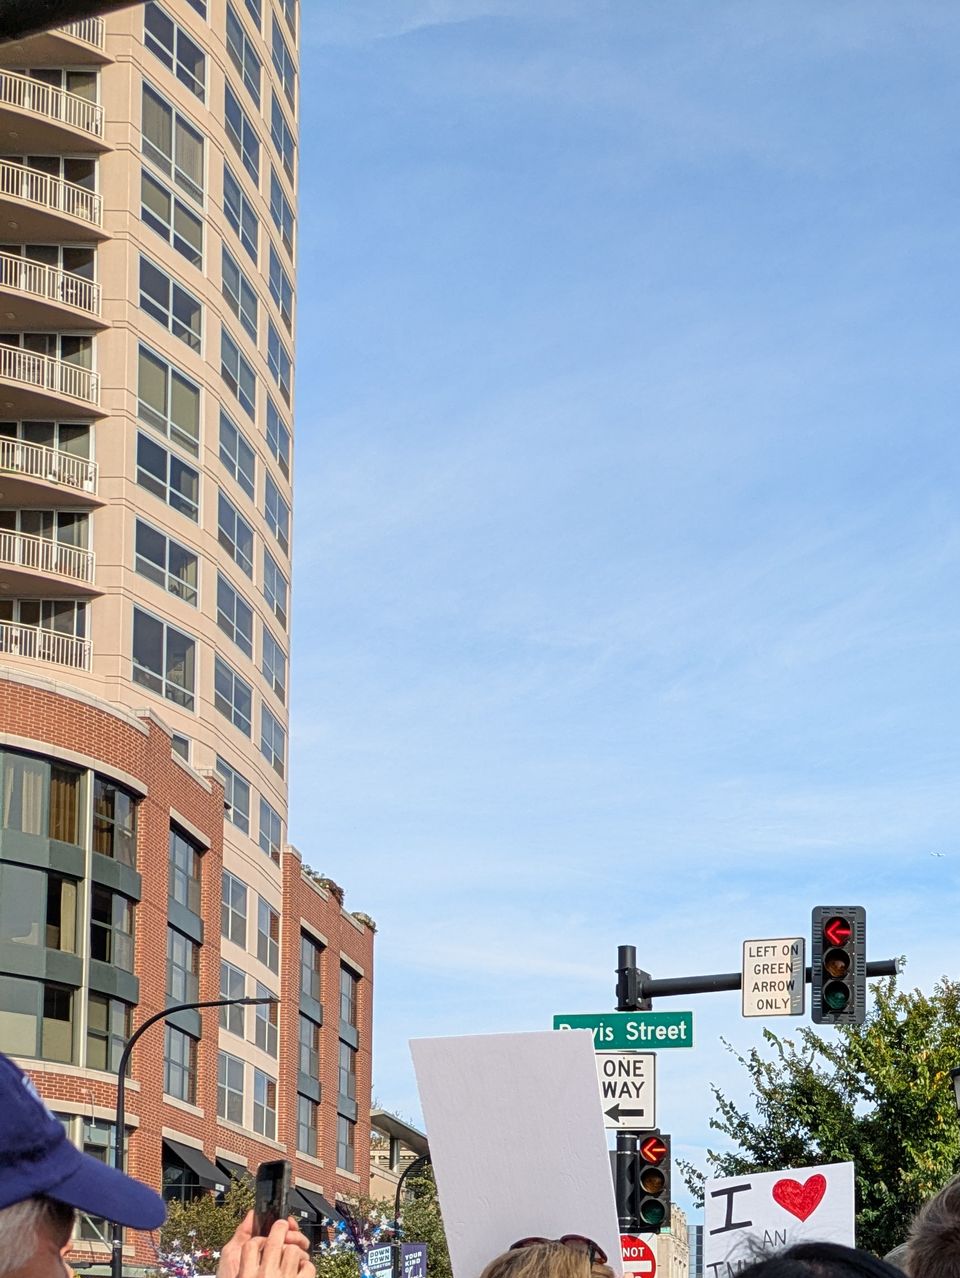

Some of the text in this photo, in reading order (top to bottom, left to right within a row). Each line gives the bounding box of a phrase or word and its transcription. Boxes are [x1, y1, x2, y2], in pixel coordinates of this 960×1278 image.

[749, 945, 799, 958] LEFT ON
[753, 962, 794, 975] GREEN
[752, 980, 795, 993] ARROW
[756, 998, 790, 1010] ONLY
[626, 1020, 687, 1041] Street
[603, 1059, 644, 1077] ONE
[602, 1081, 645, 1099] WAY
[709, 1183, 753, 1236] I
[763, 1229, 787, 1249] AN
[370, 1248, 390, 1258] DOWN
[622, 1247, 645, 1257] NOT
[370, 1255, 390, 1264] TOWN
